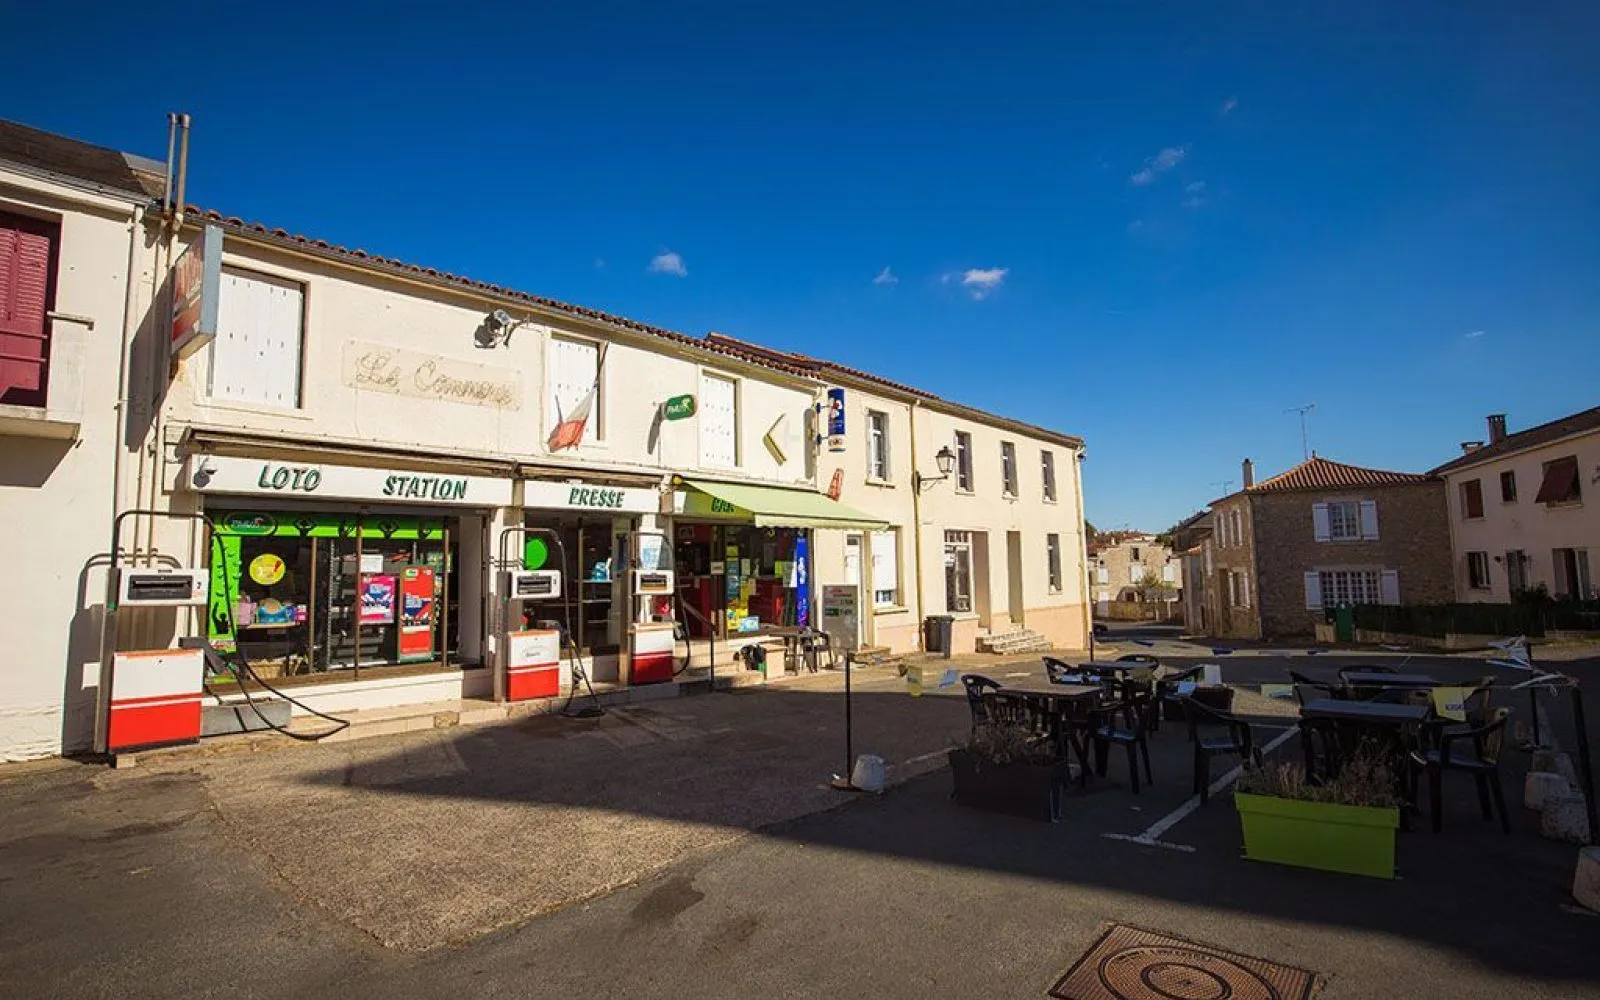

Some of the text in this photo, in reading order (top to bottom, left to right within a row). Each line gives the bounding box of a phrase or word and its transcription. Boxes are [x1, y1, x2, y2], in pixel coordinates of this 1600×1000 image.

[257, 465, 468, 499] LOTO STATION
[568, 487, 625, 508] PRESSE
